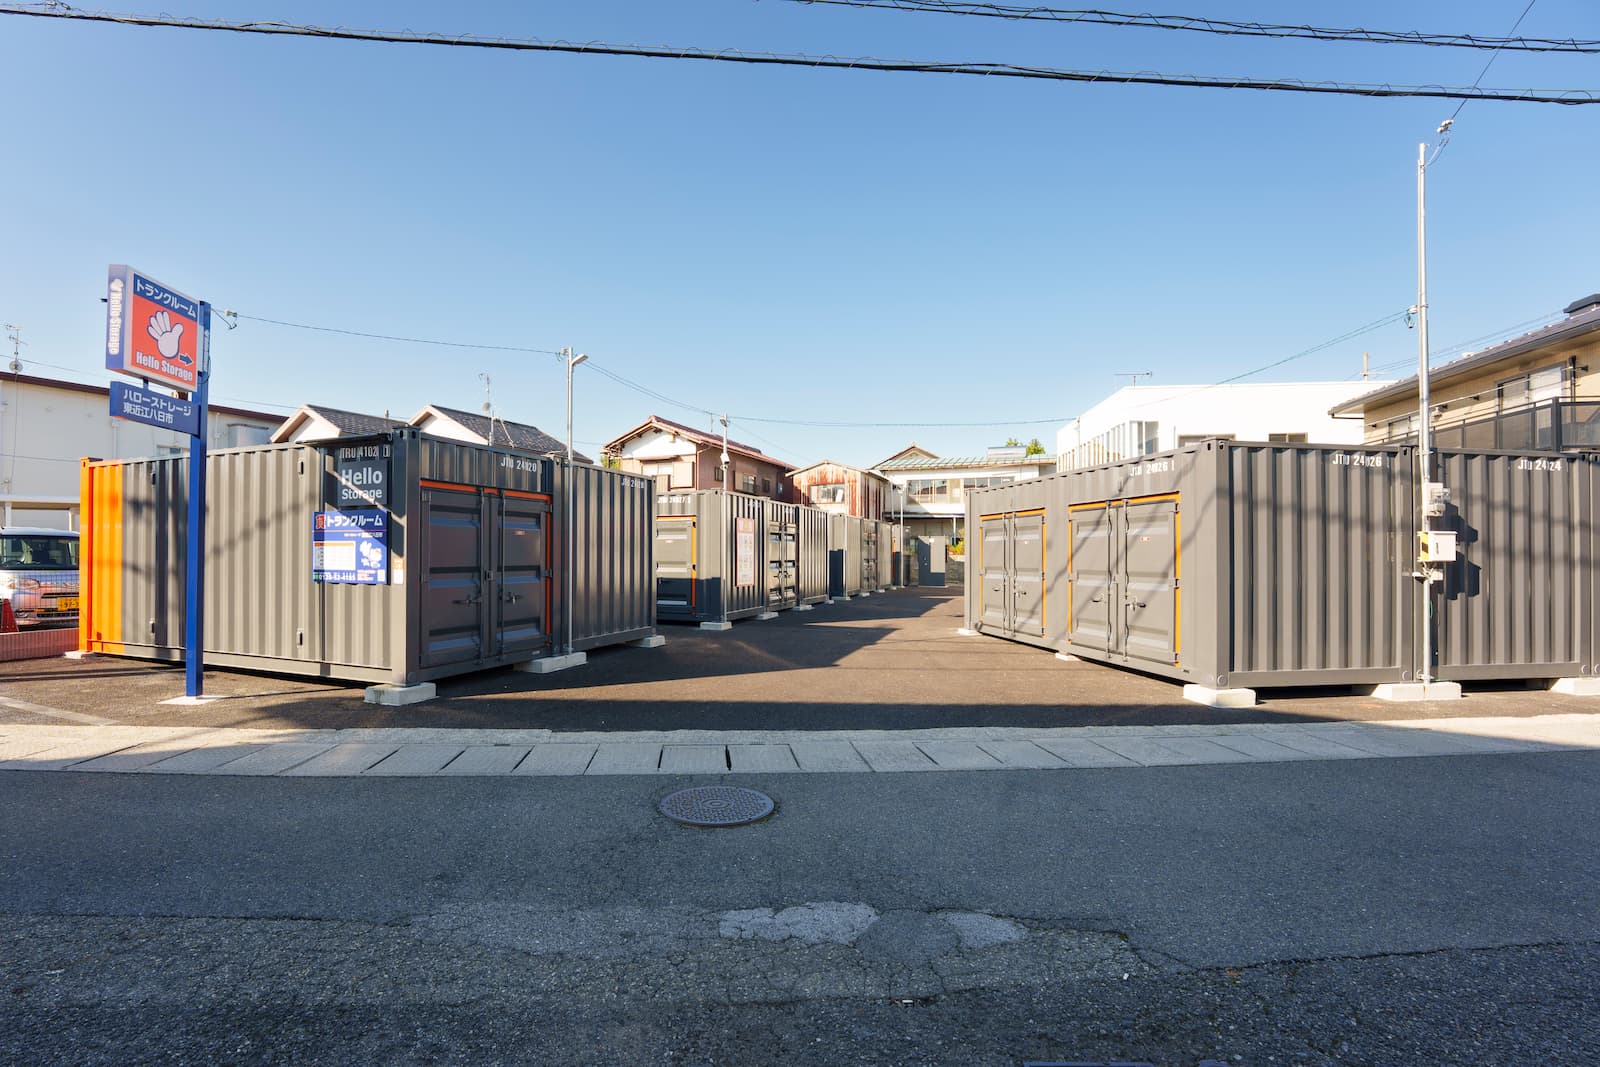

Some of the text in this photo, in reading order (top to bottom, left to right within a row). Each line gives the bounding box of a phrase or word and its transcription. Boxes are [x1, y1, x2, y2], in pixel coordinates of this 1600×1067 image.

[136, 279, 196, 318] トランクルーム
[136, 351, 193, 382] Hello Storage
[123, 389, 192, 417] ハローストレージ
[123, 402, 174, 424] 東近江八日市
[341, 467, 383, 485] Hello
[341, 488, 383, 501] Storage
